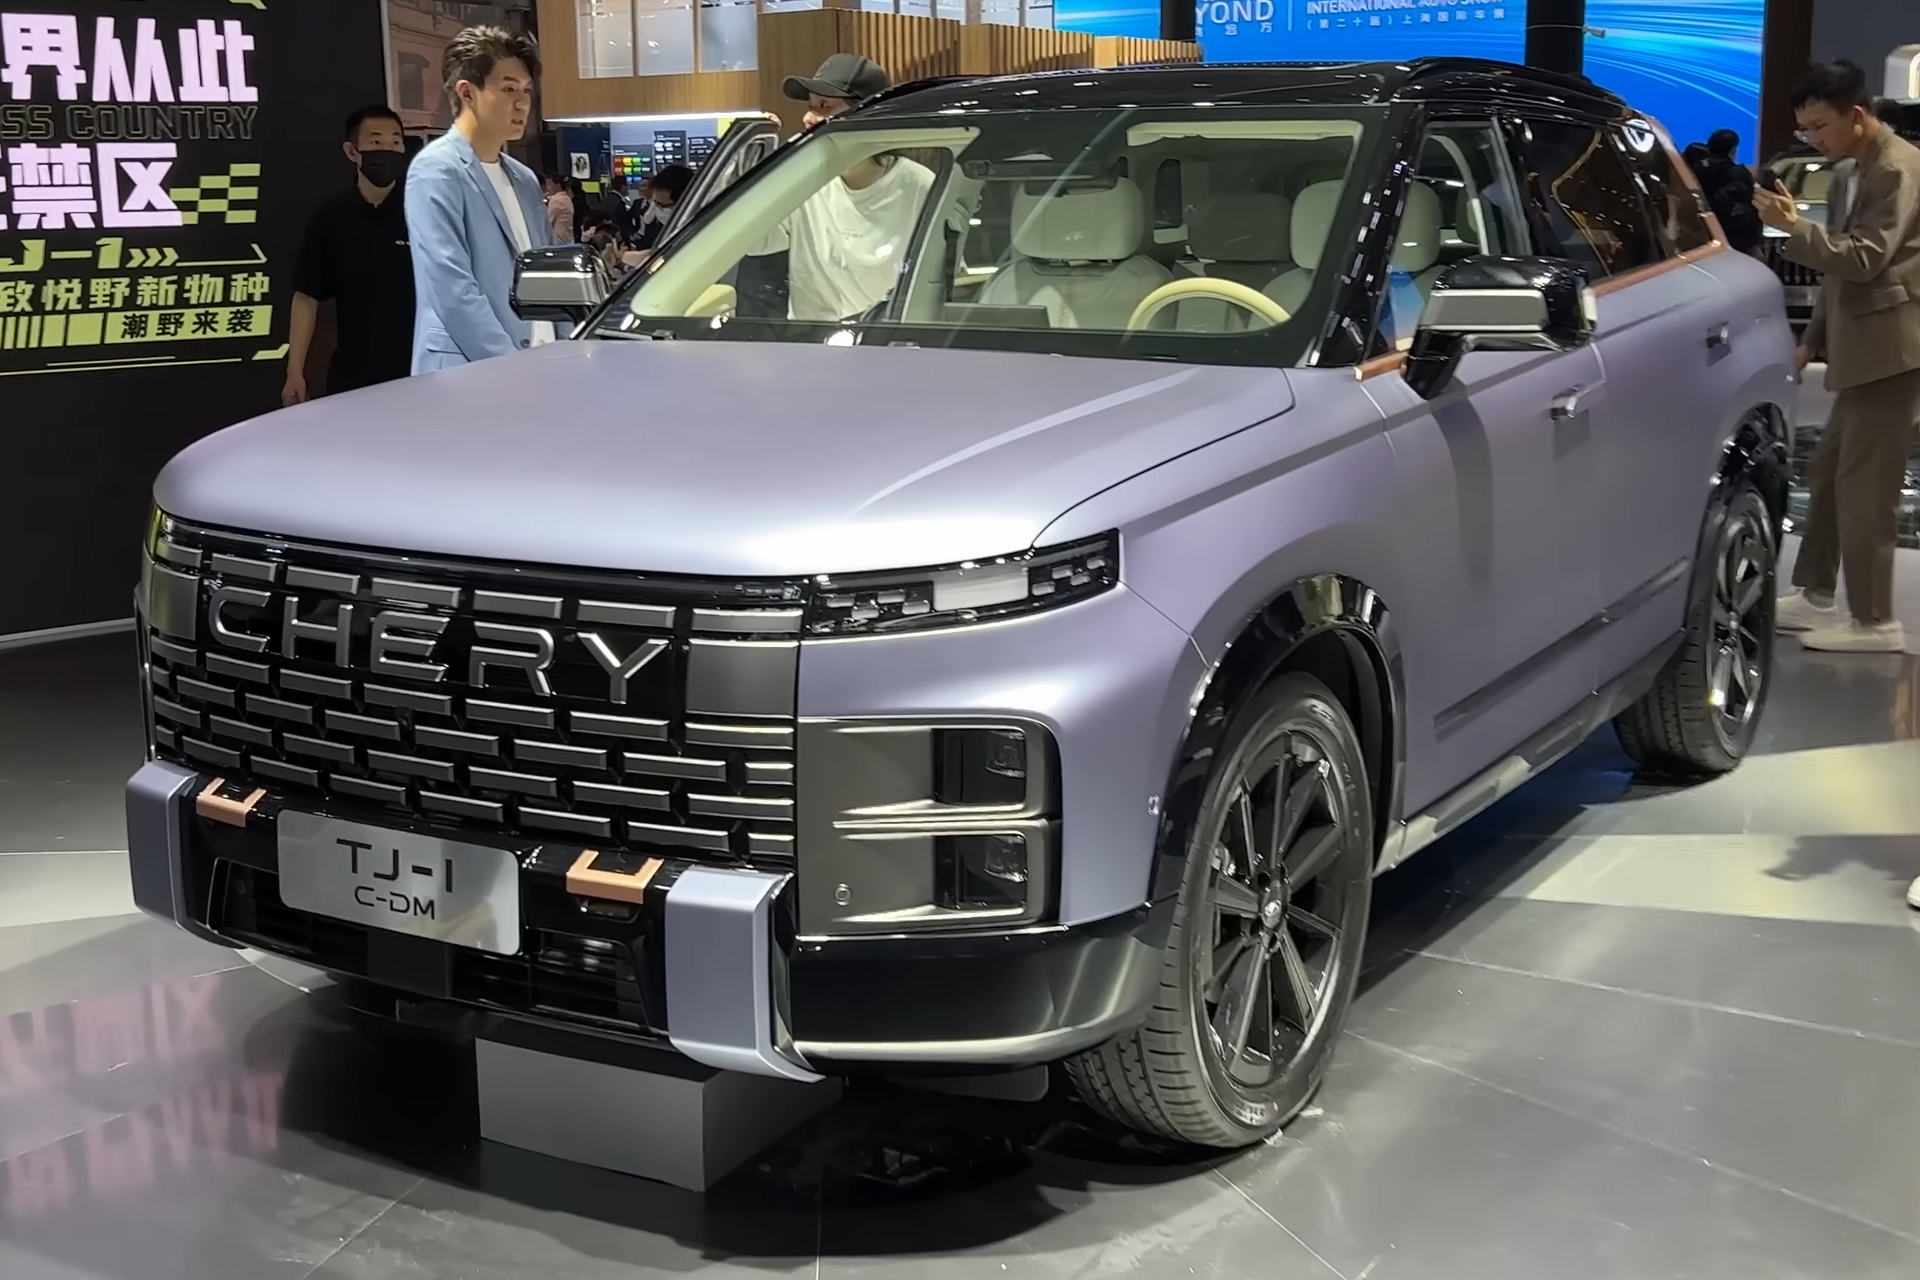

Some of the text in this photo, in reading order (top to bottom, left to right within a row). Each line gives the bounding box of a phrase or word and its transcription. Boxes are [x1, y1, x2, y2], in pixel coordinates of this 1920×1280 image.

[1306, 0, 1417, 15] INTERNATIONAL
[1, 13, 259, 102] 界从此
[66, 104, 258, 140] COUNTRY
[0, 142, 184, 230] 禁区
[0, 271, 270, 313] 致悦野新物种
[120, 309, 254, 339] 潮野来袭
[208, 584, 672, 706] CHERY
[354, 885, 436, 921] C-DM
